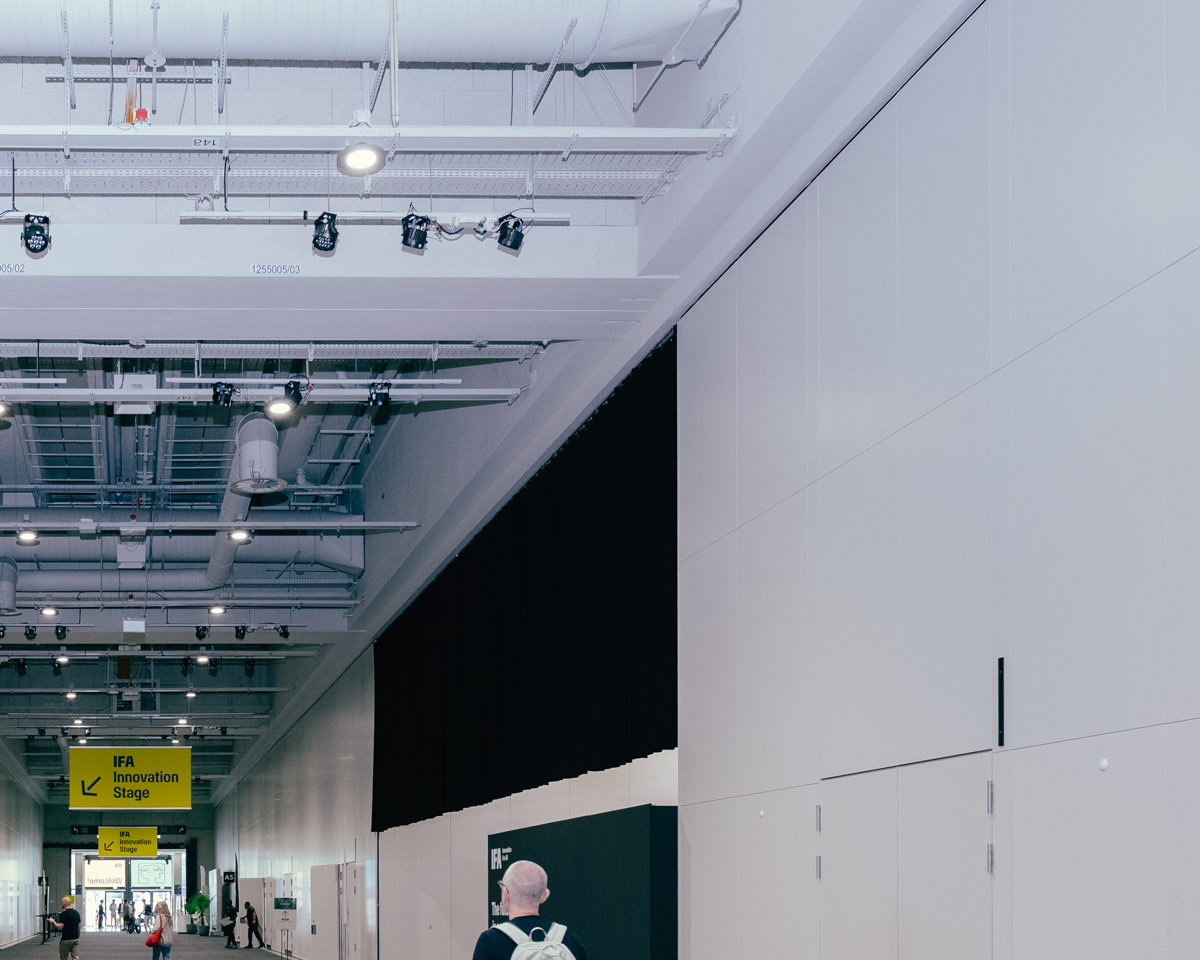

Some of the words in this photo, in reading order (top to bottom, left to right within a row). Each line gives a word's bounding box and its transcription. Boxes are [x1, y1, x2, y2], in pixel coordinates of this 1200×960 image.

[251, 264, 301, 274] 1255005/03
[113, 755, 135, 768] IFA
[113, 771, 179, 783] Innovation
[113, 786, 150, 801] Stage
[491, 847, 502, 870] IFA
